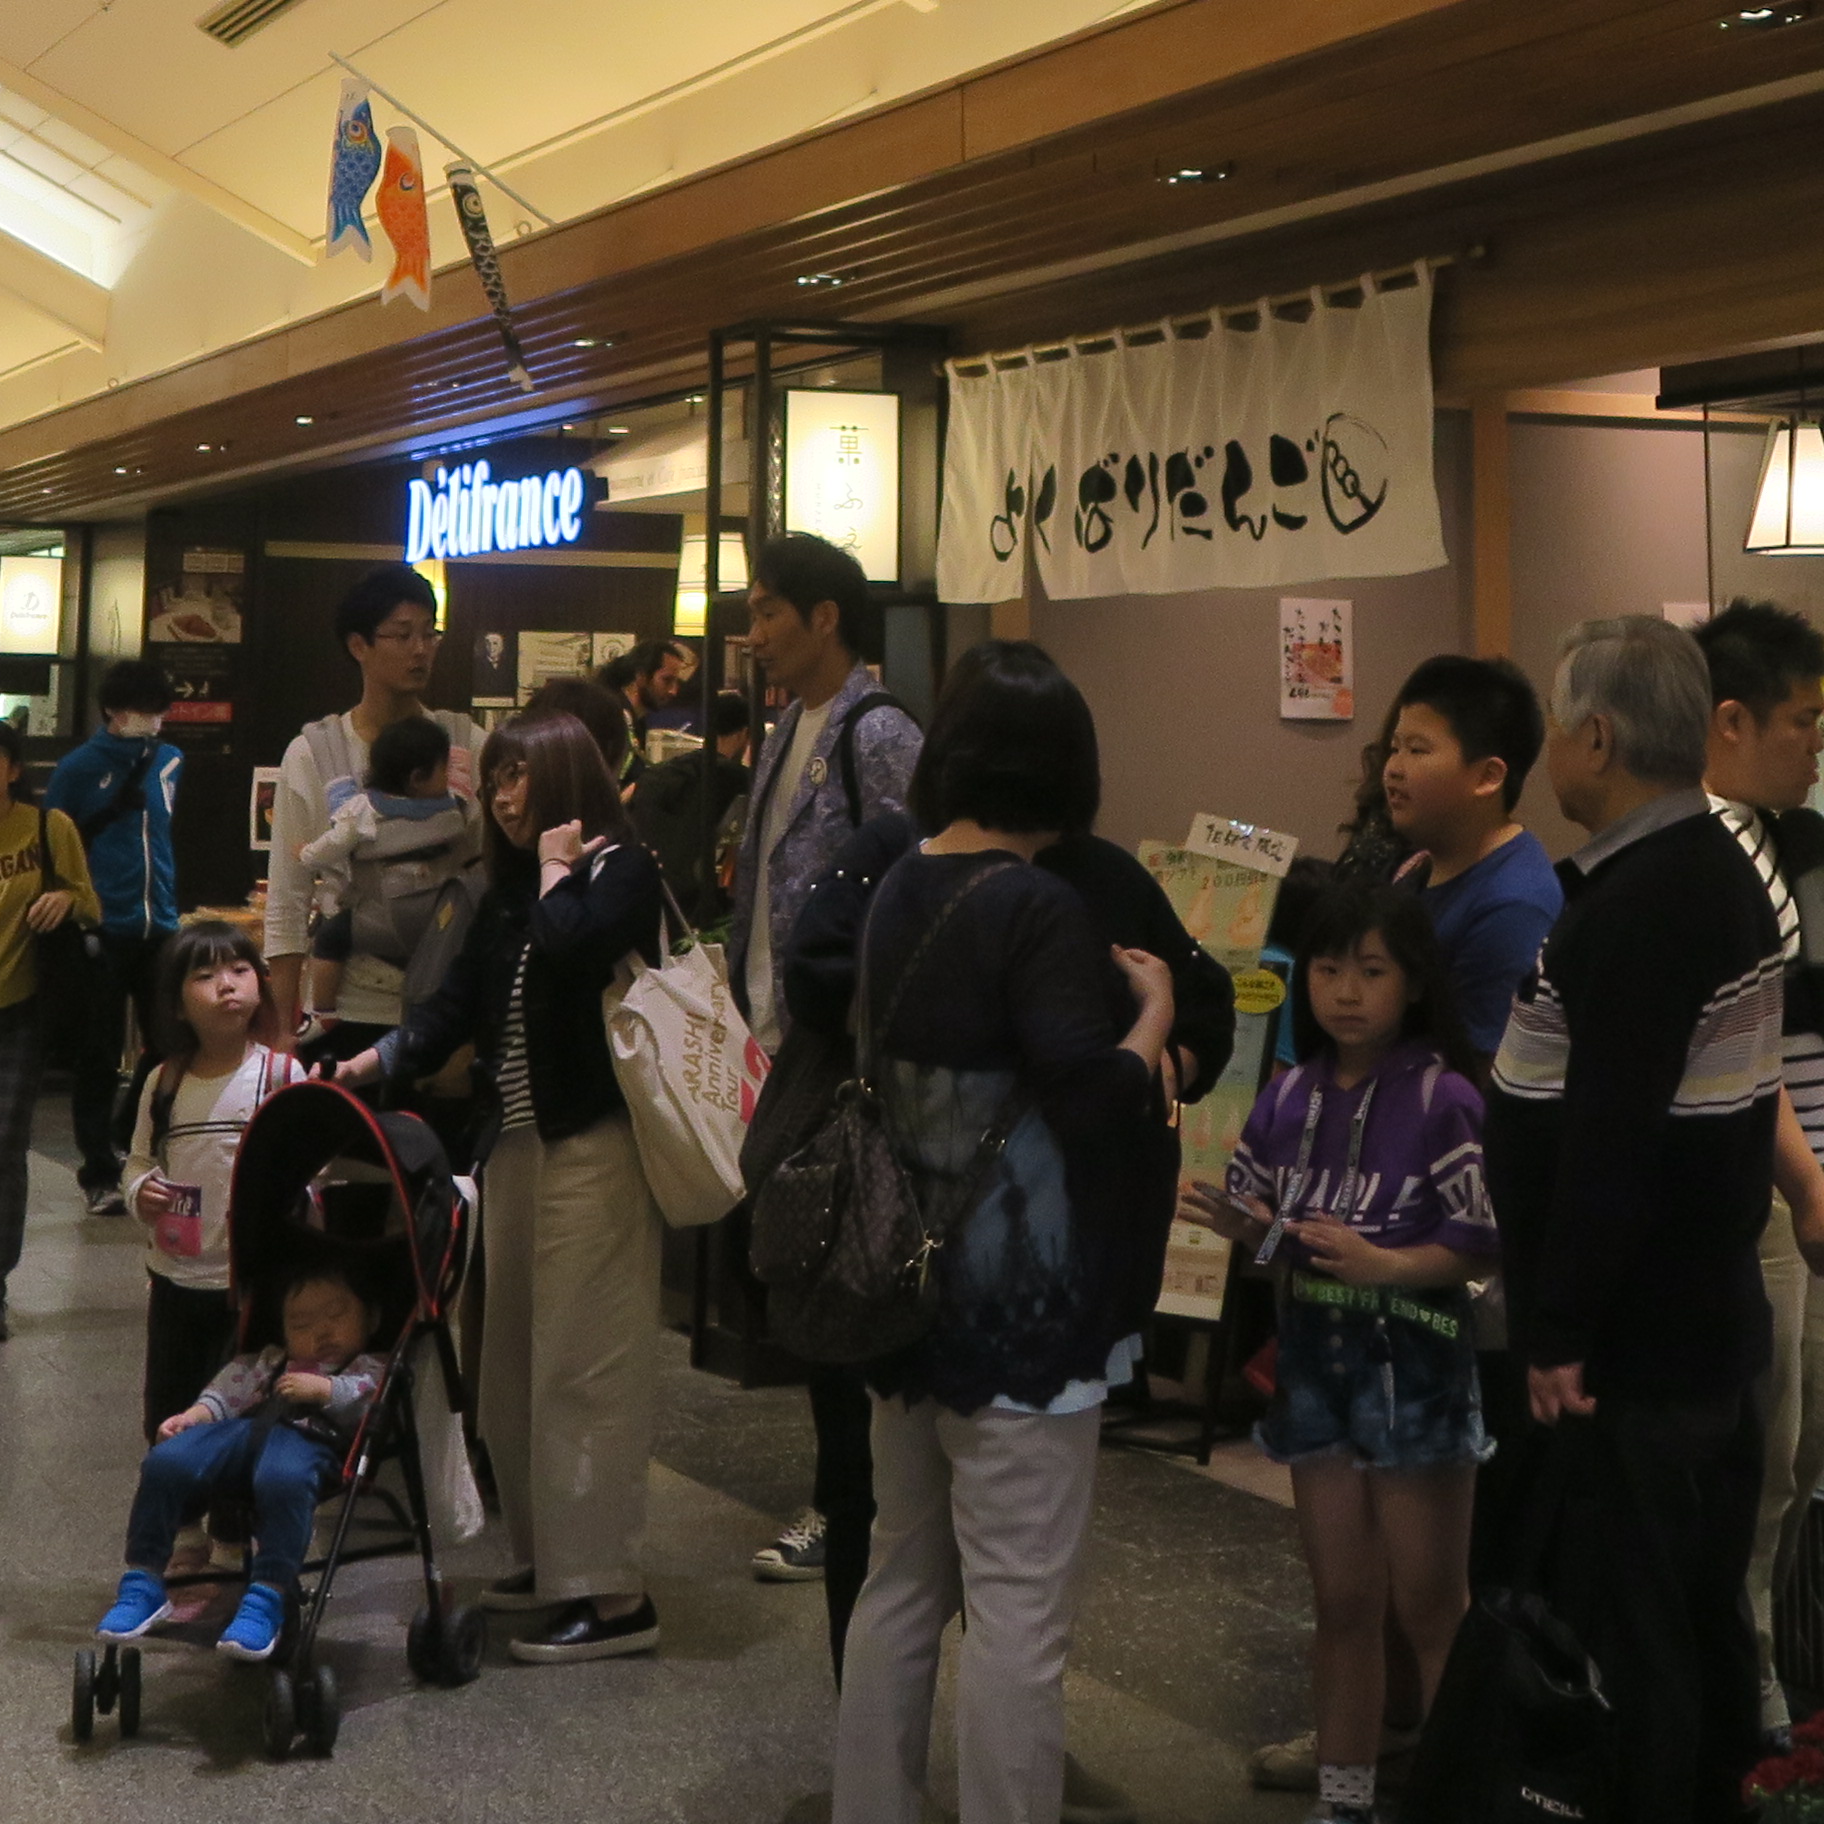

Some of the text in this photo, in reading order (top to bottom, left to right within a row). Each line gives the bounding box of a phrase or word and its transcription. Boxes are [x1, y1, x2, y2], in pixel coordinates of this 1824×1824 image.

[405, 458, 584, 563] Délifrance
[990, 430, 1321, 562] よくばりだんご
[721, 1065, 739, 1113] Tour
